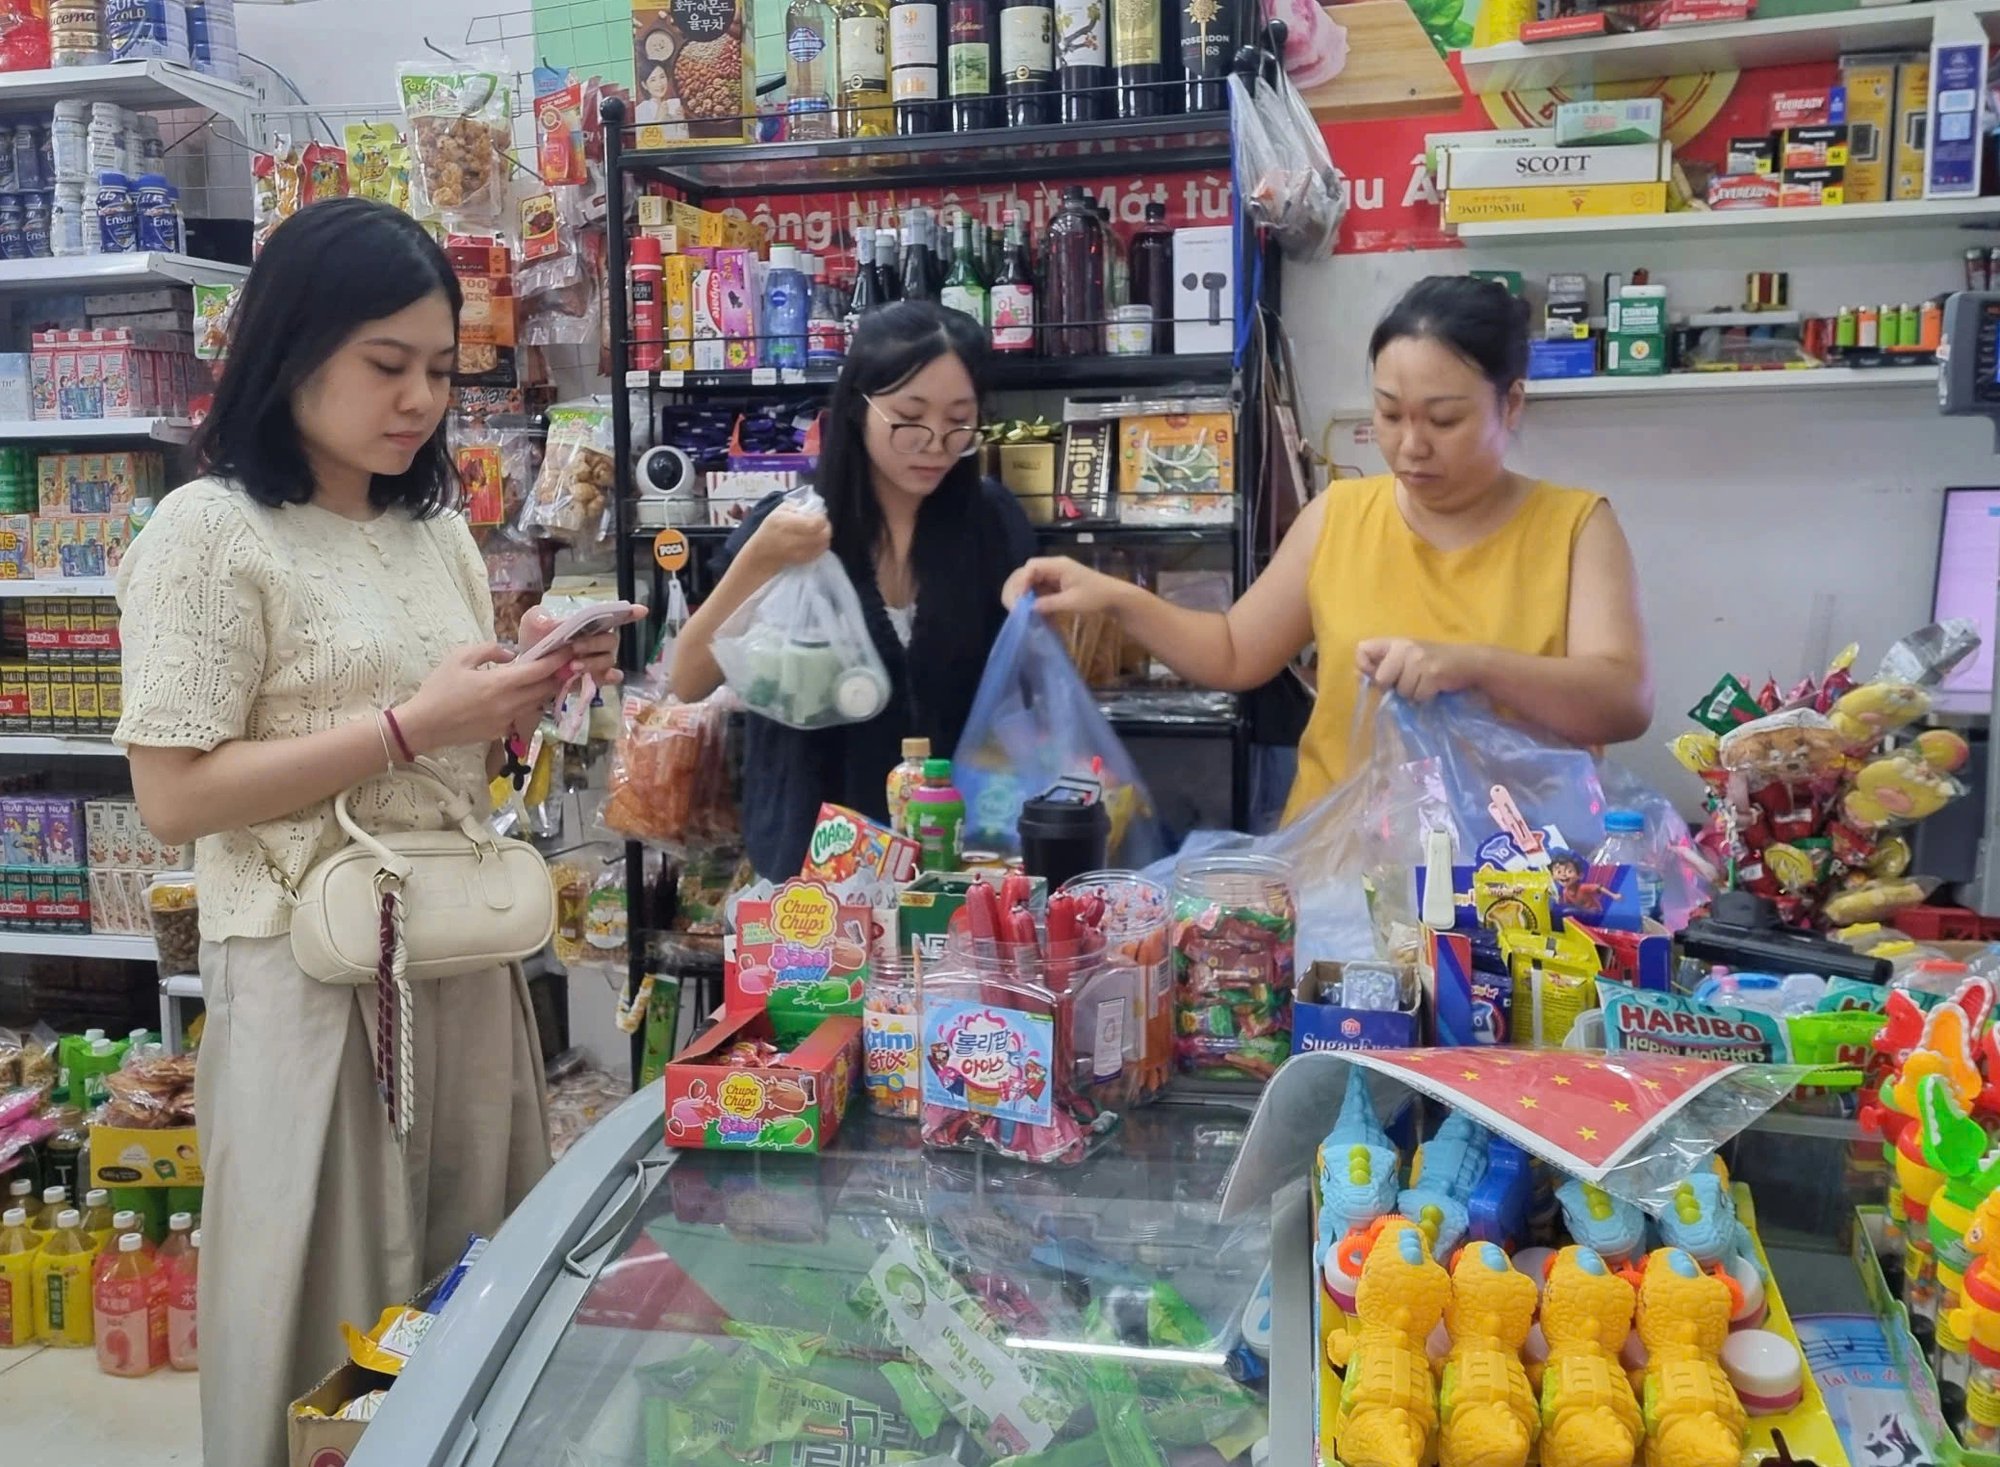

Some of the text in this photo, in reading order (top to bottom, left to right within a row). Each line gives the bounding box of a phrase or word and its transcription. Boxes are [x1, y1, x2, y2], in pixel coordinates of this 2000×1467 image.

[686, 13, 726, 31] 율무차
[1515, 154, 1592, 174] SCOTT
[711, 272, 722, 320] Colgate
[782, 899, 827, 920] Chupa
[780, 914, 826, 939] Chups
[1619, 1003, 1763, 1043] HARIBO
[954, 1029, 1011, 1055] 롤리팝
[961, 1057, 1006, 1078] 아이스
[725, 1083, 759, 1099] Chupa
[723, 1094, 757, 1112] Chups
[940, 1326, 968, 1361] Non
